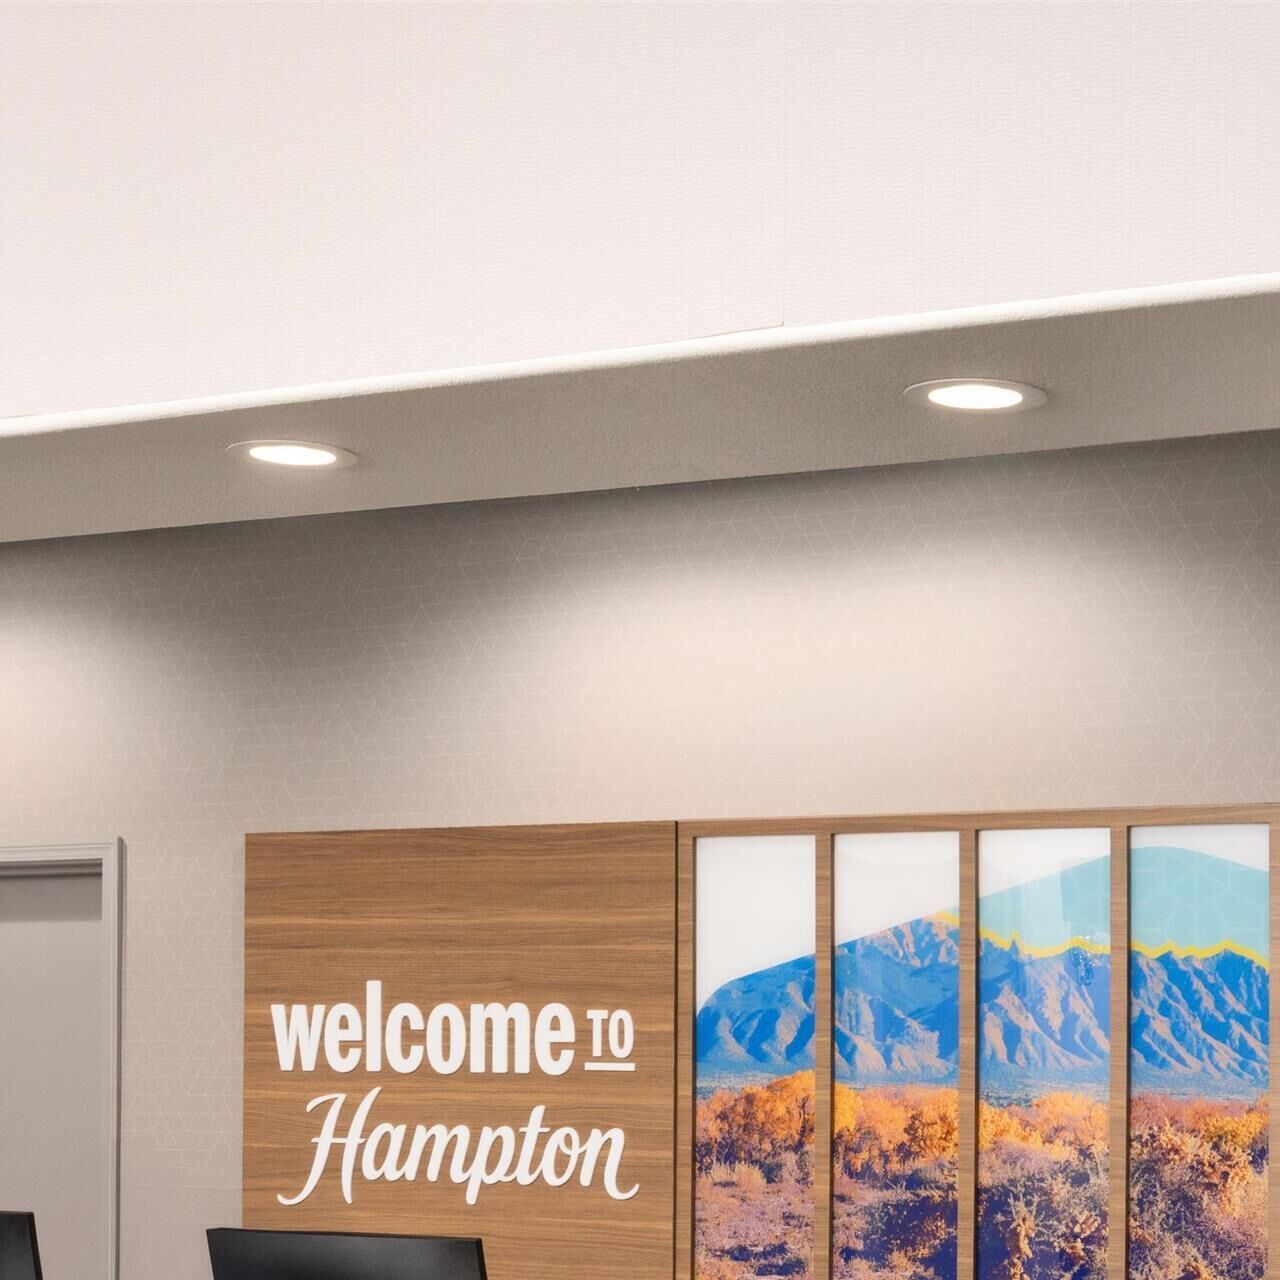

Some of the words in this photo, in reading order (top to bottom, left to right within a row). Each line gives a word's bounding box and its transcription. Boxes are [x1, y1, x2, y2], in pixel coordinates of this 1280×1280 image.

[271, 980, 576, 1076] welcome
[585, 1009, 635, 1060] TO
[276, 1087, 640, 1206] Hampton
